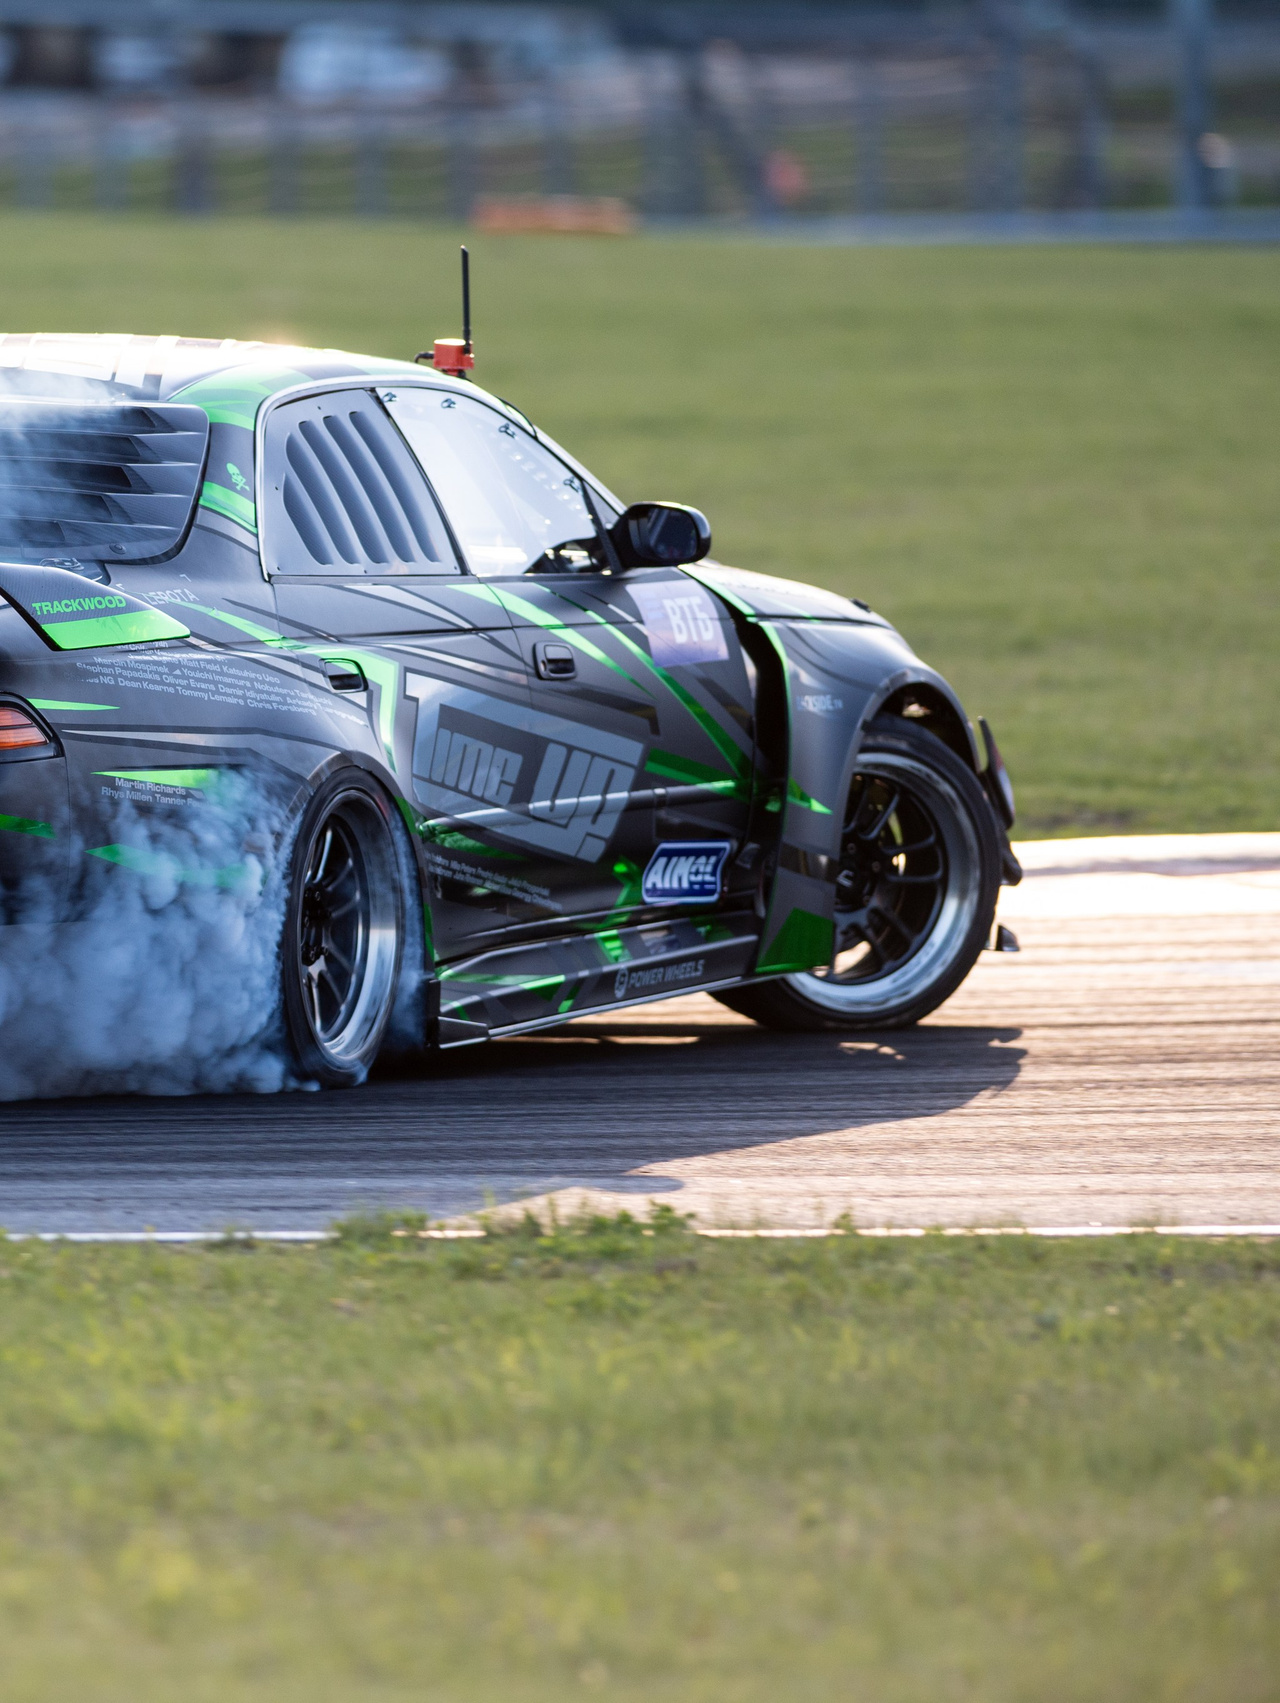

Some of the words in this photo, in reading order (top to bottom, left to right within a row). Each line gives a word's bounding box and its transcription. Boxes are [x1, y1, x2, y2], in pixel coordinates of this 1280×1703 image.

[31, 595, 127, 616] TRACKWOOD
[92, 656, 127, 668] Marcin
[128, 660, 170, 674] Mospinek
[182, 667, 213, 680] Youichi
[213, 673, 251, 688] Imamura
[253, 681, 295, 696] Nobuteru
[180, 658, 200, 668] Matt
[200, 661, 221, 672] Field
[222, 665, 263, 681] Katsuhiro
[262, 673, 281, 684] Ueo
[99, 675, 115, 685] NG
[118, 677, 142, 689] Dean
[142, 681, 175, 694] Kearne
[176, 686, 209, 700] Tommy
[209, 691, 245, 706] Lemaire
[247, 699, 272, 710] Chris
[272, 702, 317, 716] Forsberg
[115, 667, 161, 681] Papadakis
[162, 674, 189, 686] Oliver
[190, 679, 216, 691] Evans
[218, 684, 244, 697] Damir
[245, 687, 283, 703] Idiyatulin
[101, 786, 125, 799] Rhys
[126, 790, 153, 802] Millen
[154, 794, 186, 806] Tanner
[115, 778, 146, 790] Martin
[146, 782, 187, 796] Richards
[628, 967, 664, 988] POWER
[664, 959, 705, 982] WHEELS
